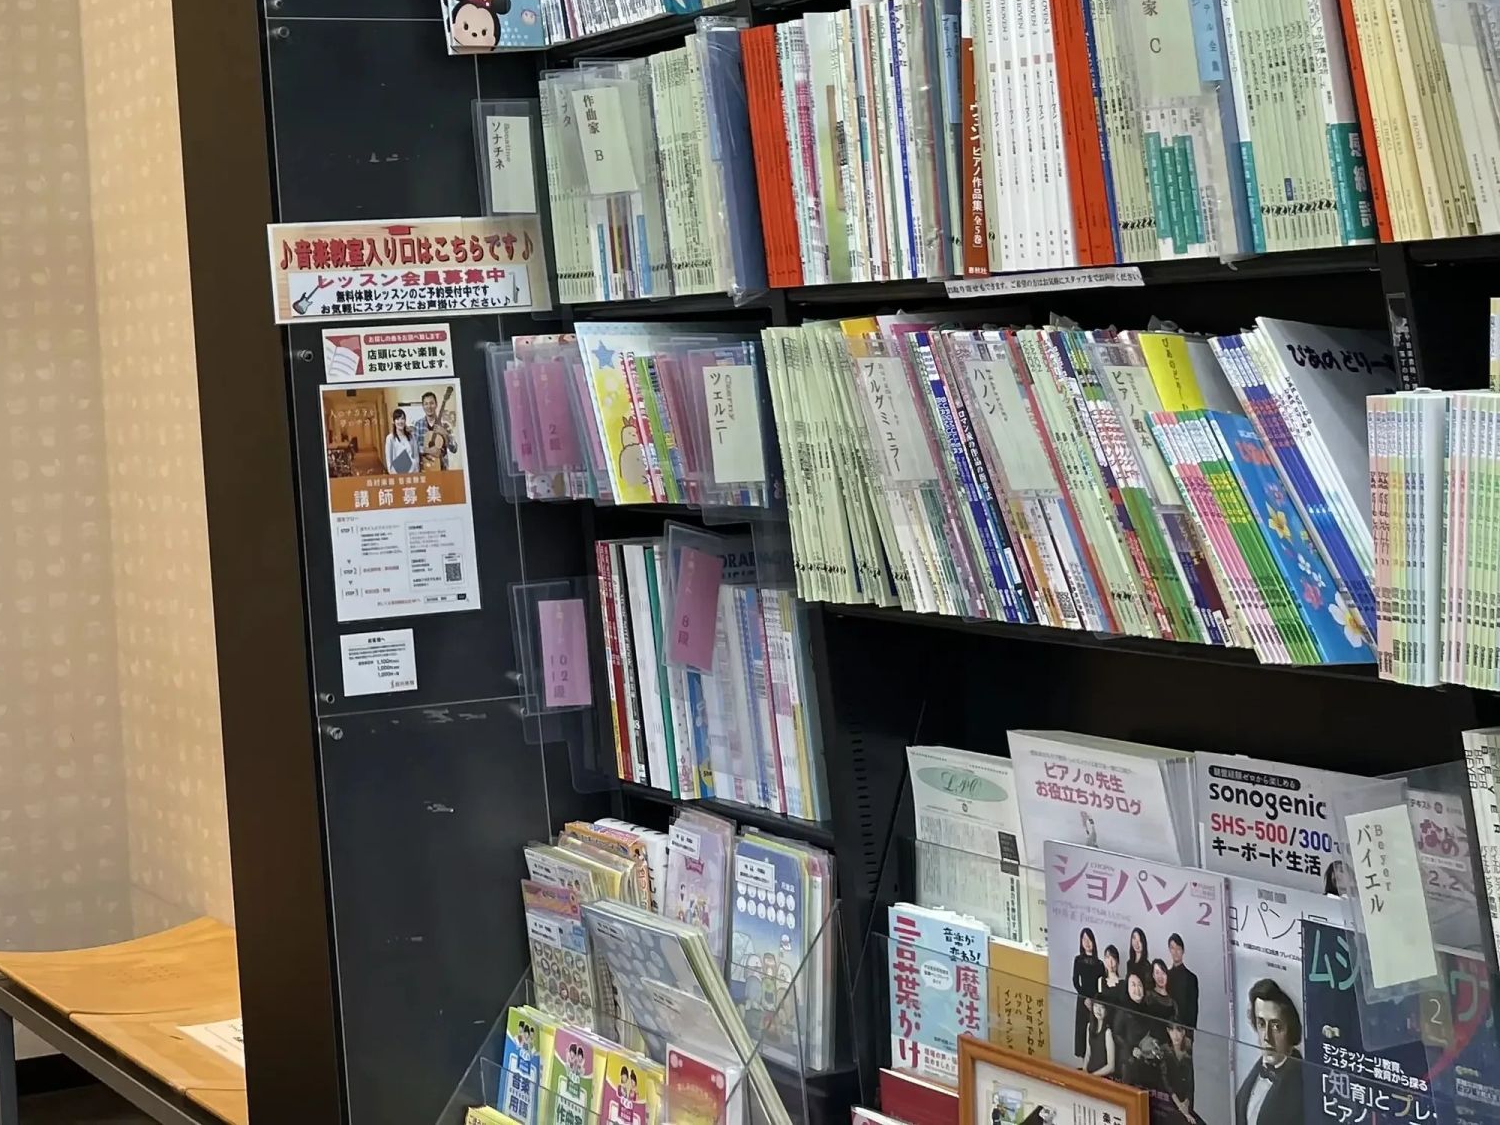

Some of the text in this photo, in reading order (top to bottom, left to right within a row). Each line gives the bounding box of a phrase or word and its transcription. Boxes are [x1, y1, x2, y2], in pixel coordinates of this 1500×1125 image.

[1150, 37, 1162, 56] C
[491, 121, 505, 170] ソナチネ
[583, 94, 604, 162] 作曲家 B
[317, 267, 506, 290] レッスン会員募集中
[336, 285, 489, 303] 無料体験レッスンのご予約受付中です
[367, 345, 446, 360] 店頭にない楽譜も
[368, 359, 449, 372] お取り寄せ致します。
[710, 371, 728, 445] ツェルニー
[974, 369, 996, 415] ハノン
[864, 362, 901, 472] ブルグミュラー
[354, 485, 442, 508] 講師募集
[1044, 761, 1125, 794] ピアノの先生
[1035, 779, 1142, 816] お役立ちカタログ
[1208, 782, 1327, 821] sonogenic
[1211, 836, 1322, 877] キーボード生活
[1357, 824, 1385, 914] バイエル
[1374, 824, 1392, 892] Beyer
[1052, 854, 1188, 916] ショパン
[1195, 902, 1213, 926] 2
[943, 927, 975, 947] 音楽が
[893, 915, 922, 1069] 言葉がけ
[1429, 997, 1443, 1026] 2
[1322, 1053, 1429, 1092] シュタイナー教育から探る
[1322, 1096, 1368, 1124] ピアノ
